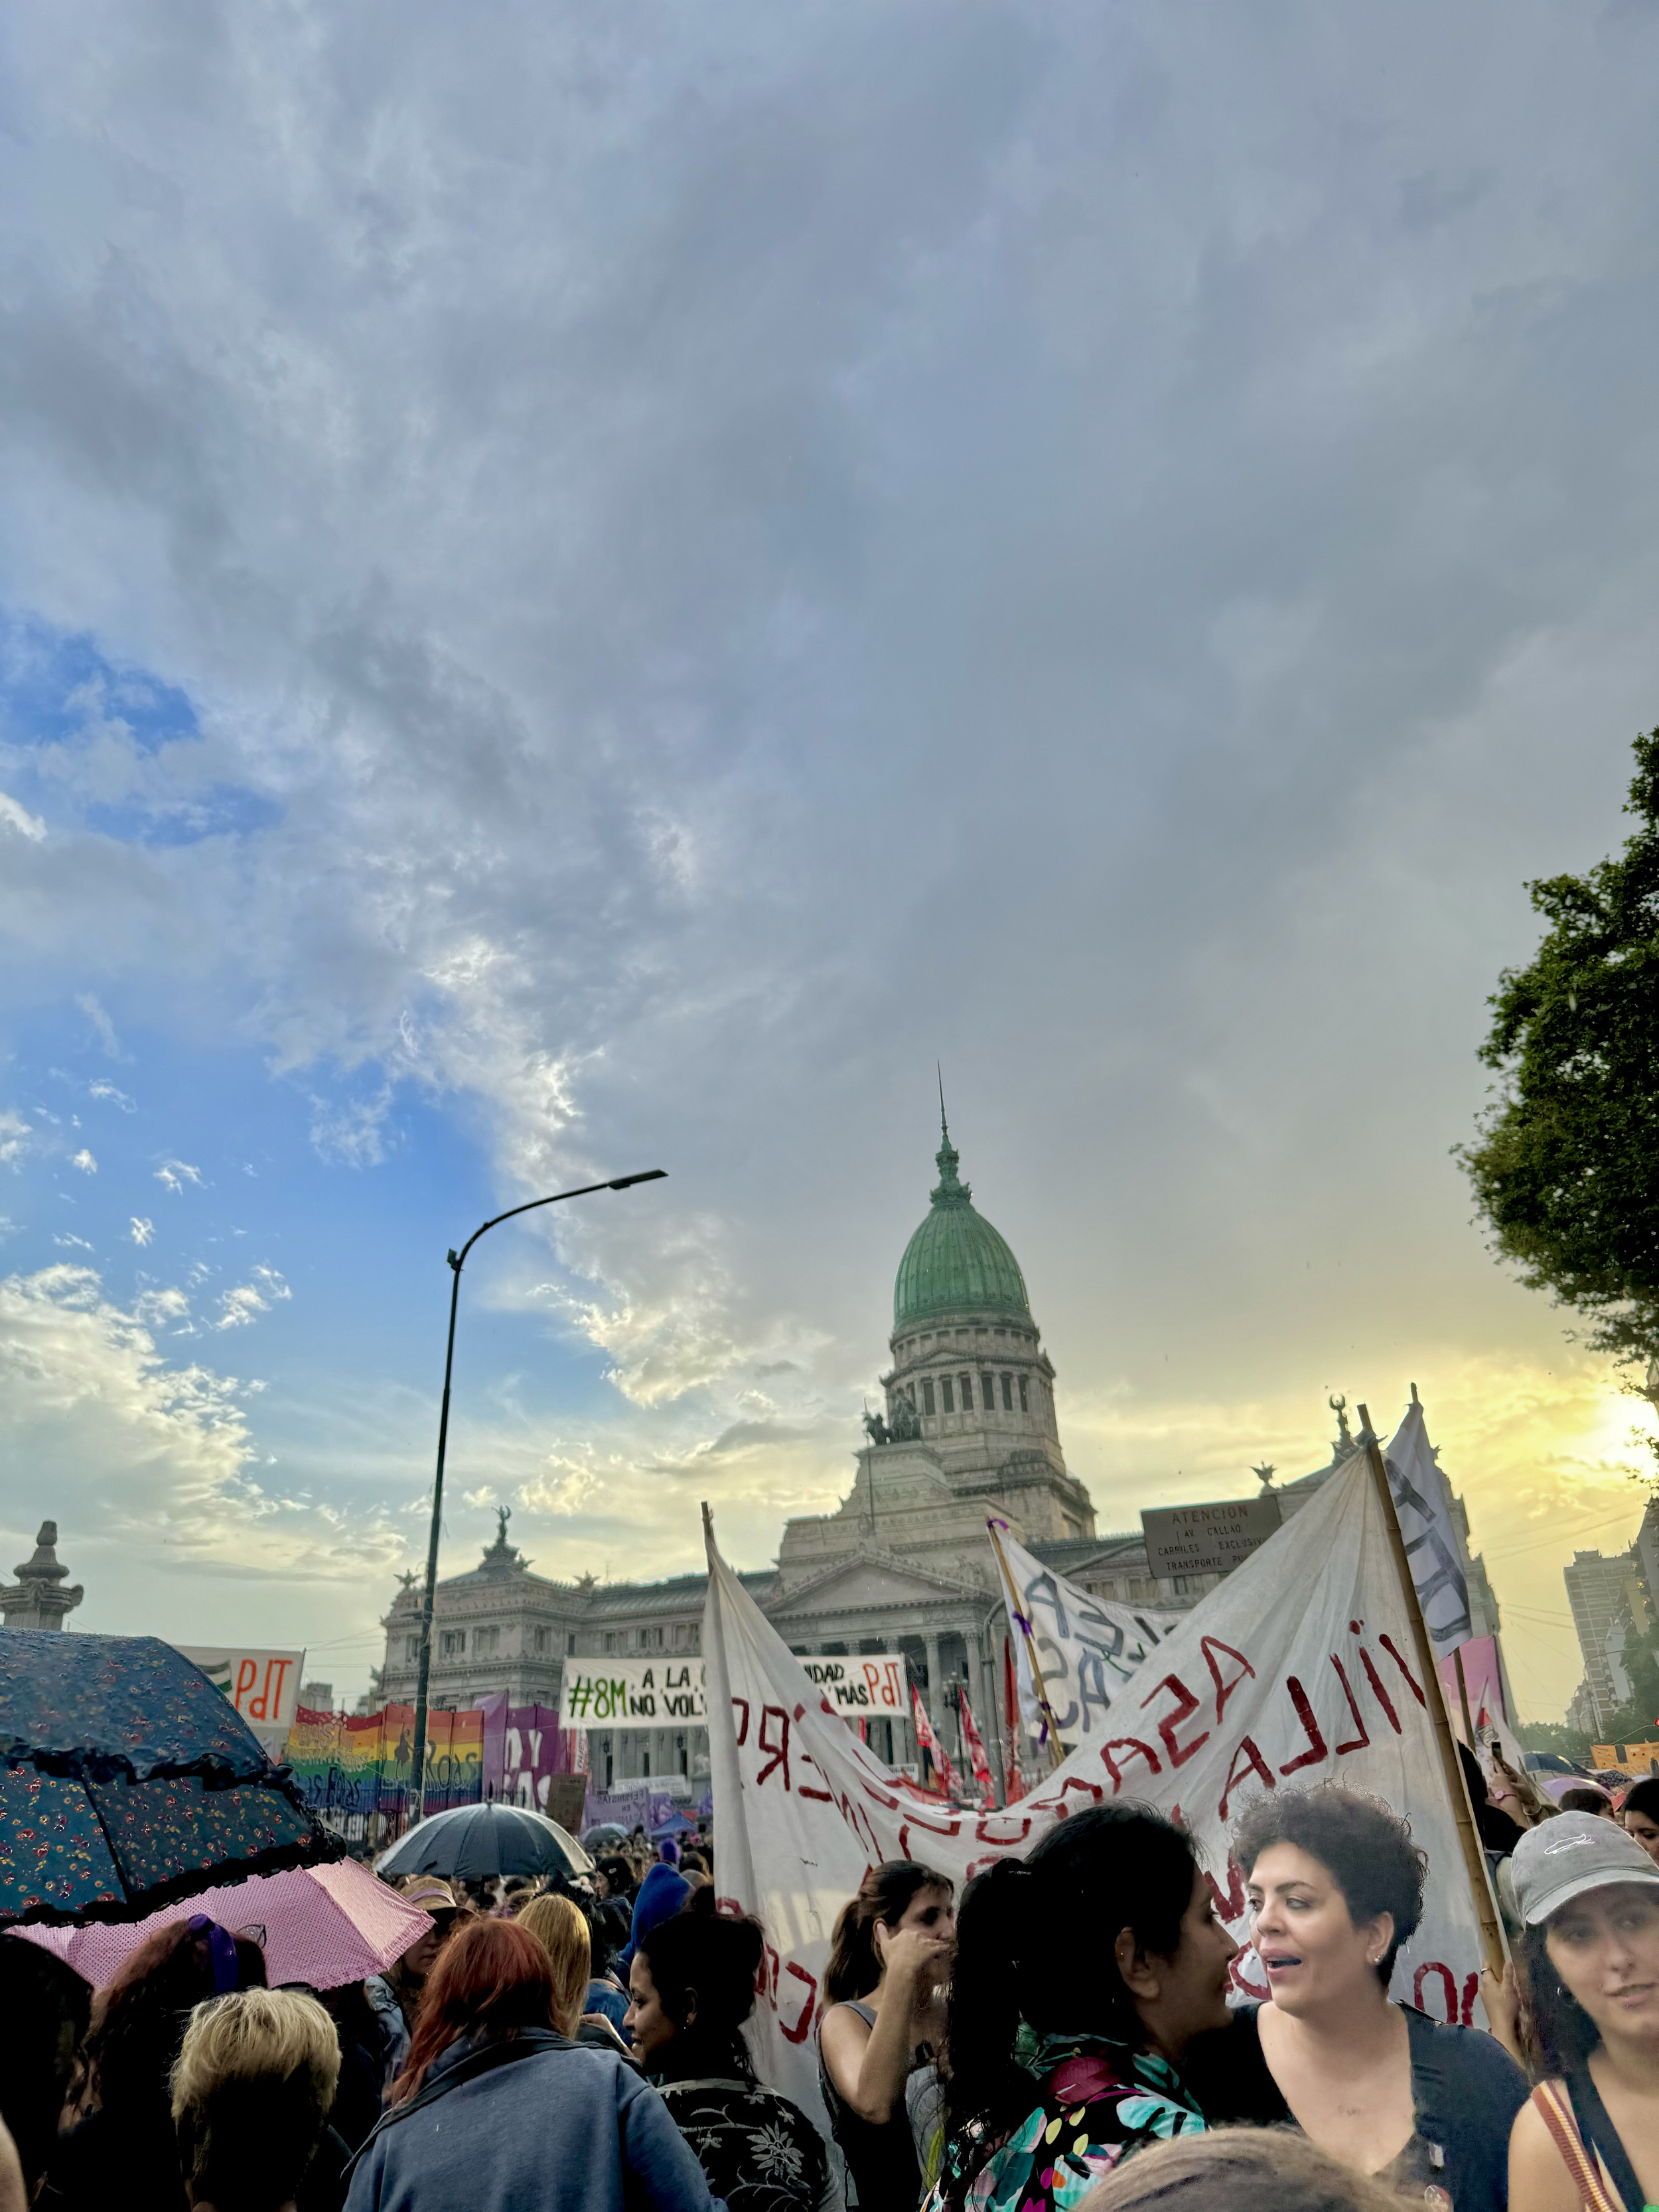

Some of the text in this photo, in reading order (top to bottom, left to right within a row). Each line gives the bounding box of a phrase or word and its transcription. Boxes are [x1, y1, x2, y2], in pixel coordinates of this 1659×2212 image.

[1172, 1505, 1248, 1525] ATENCION
[1207, 1524, 1241, 1536] CALLAO
[1167, 1556, 1223, 1572] TRANSPORTE
[642, 1667, 654, 1688] A
[666, 1665, 690, 1688] LA
[863, 1662, 902, 1707] PdT
[235, 1659, 293, 1720] PdT
[569, 1674, 626, 1718] #8M
[630, 1694, 656, 1716] NO
[664, 1693, 707, 1717] VOL
